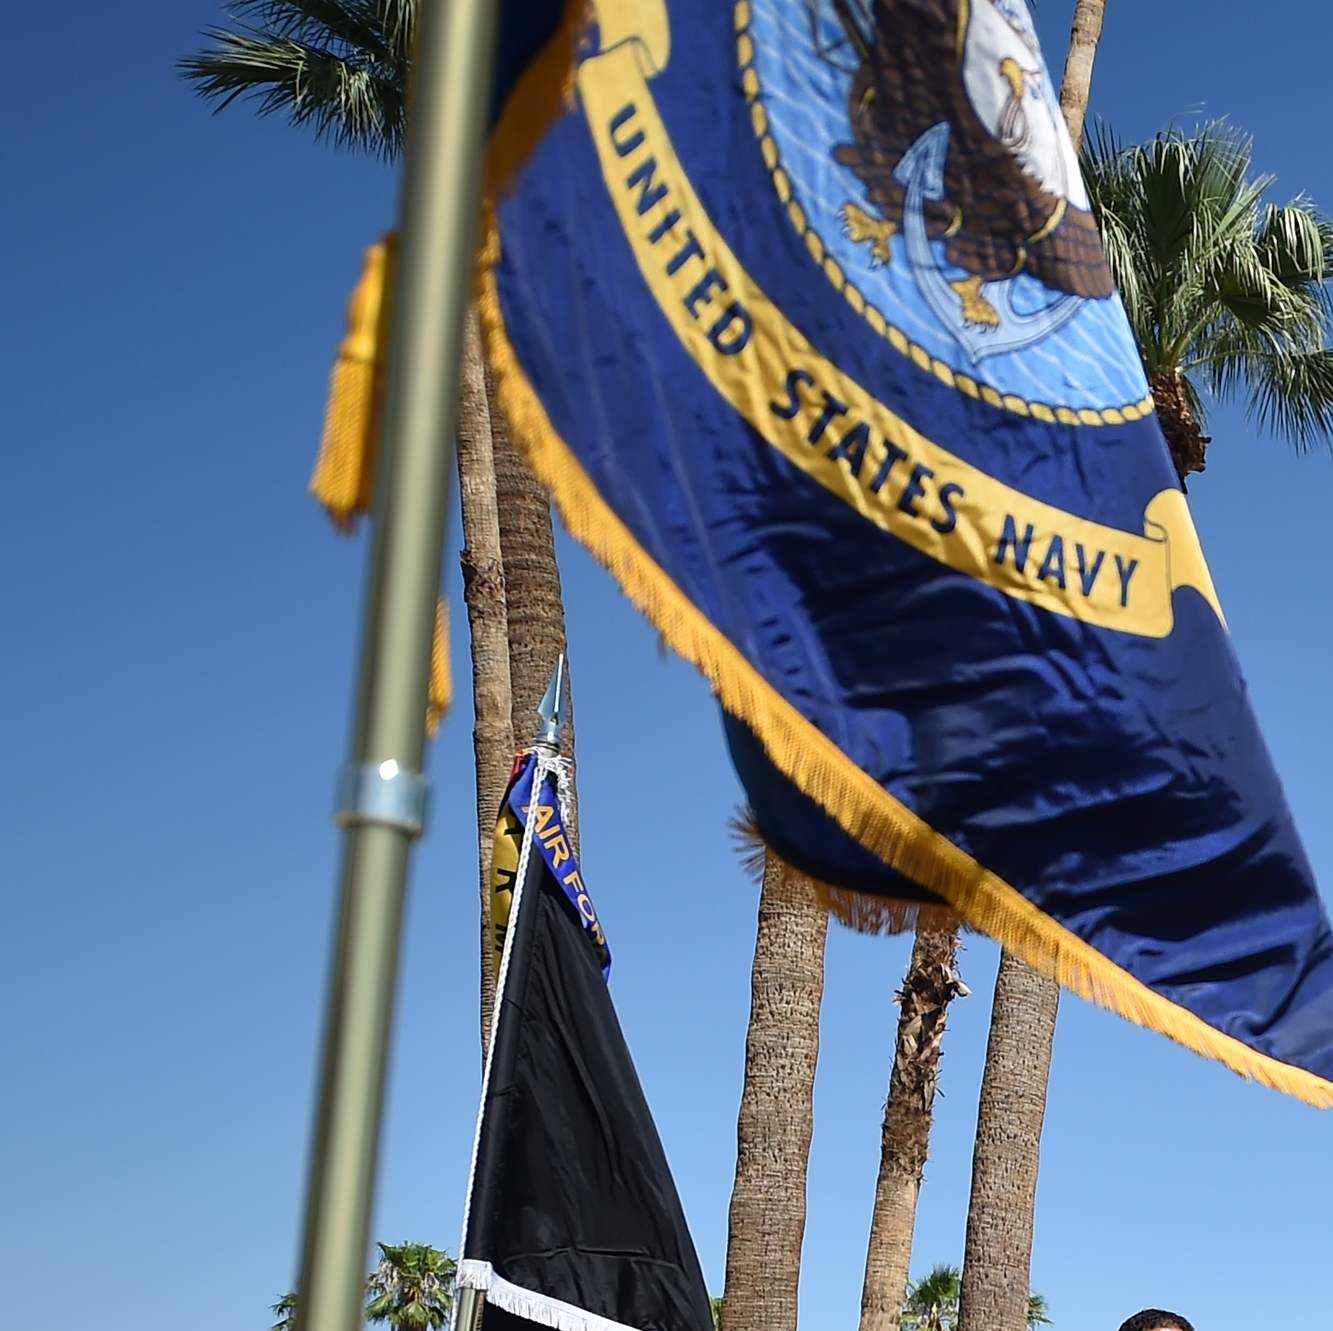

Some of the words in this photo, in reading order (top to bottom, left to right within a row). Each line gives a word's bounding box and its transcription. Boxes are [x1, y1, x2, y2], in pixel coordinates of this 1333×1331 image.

[608, 102, 755, 357] UNITED
[769, 368, 965, 535] STATES
[993, 513, 1140, 609] NAVY
[521, 805, 570, 869] AIR
